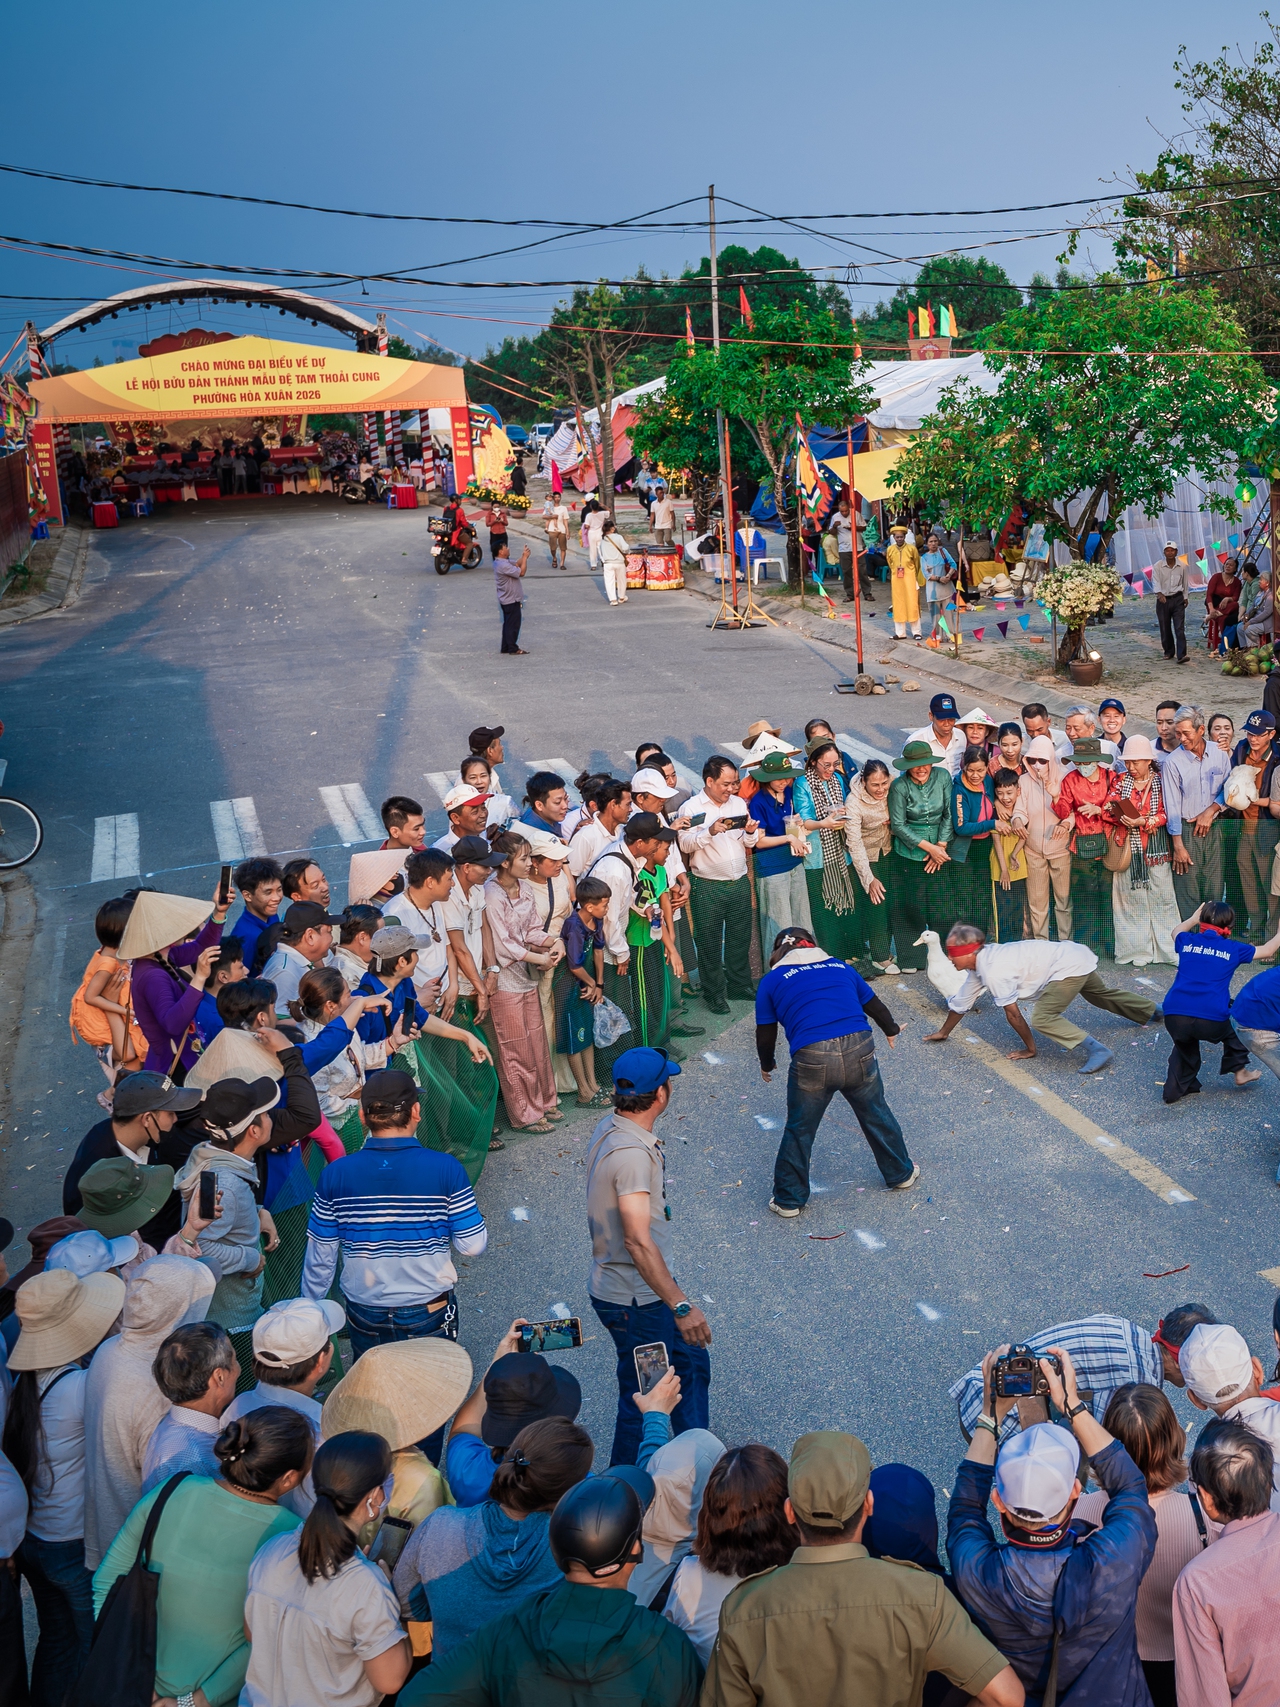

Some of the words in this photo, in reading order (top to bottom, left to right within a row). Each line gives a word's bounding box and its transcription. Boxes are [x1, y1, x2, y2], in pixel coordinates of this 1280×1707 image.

[181, 360, 210, 372] CHÀO
[213, 358, 246, 371] MỪNG
[248, 359, 267, 371] ĐẠI
[269, 356, 293, 369] BIỂU
[296, 355, 309, 368] VỀ
[311, 357, 326, 369] DỰ
[126, 377, 139, 391] LỄ
[142, 376, 160, 390] HỘI
[164, 374, 185, 389] BỬU
[188, 374, 211, 388] ĐẢN
[214, 374, 249, 388] THÁNH
[252, 372, 276, 386] MẪU
[279, 373, 293, 387] ĐỆ
[296, 373, 317, 384] TAM
[319, 371, 350, 383] THOẢI
[352, 372, 380, 382] CUNG
[193, 390, 237, 404] PHƯỜNG
[240, 391, 261, 402] HÒA
[264, 390, 293, 402] XUÂN
[296, 390, 321, 400] 2026
[1030, 1529, 1063, 1543] Canon
